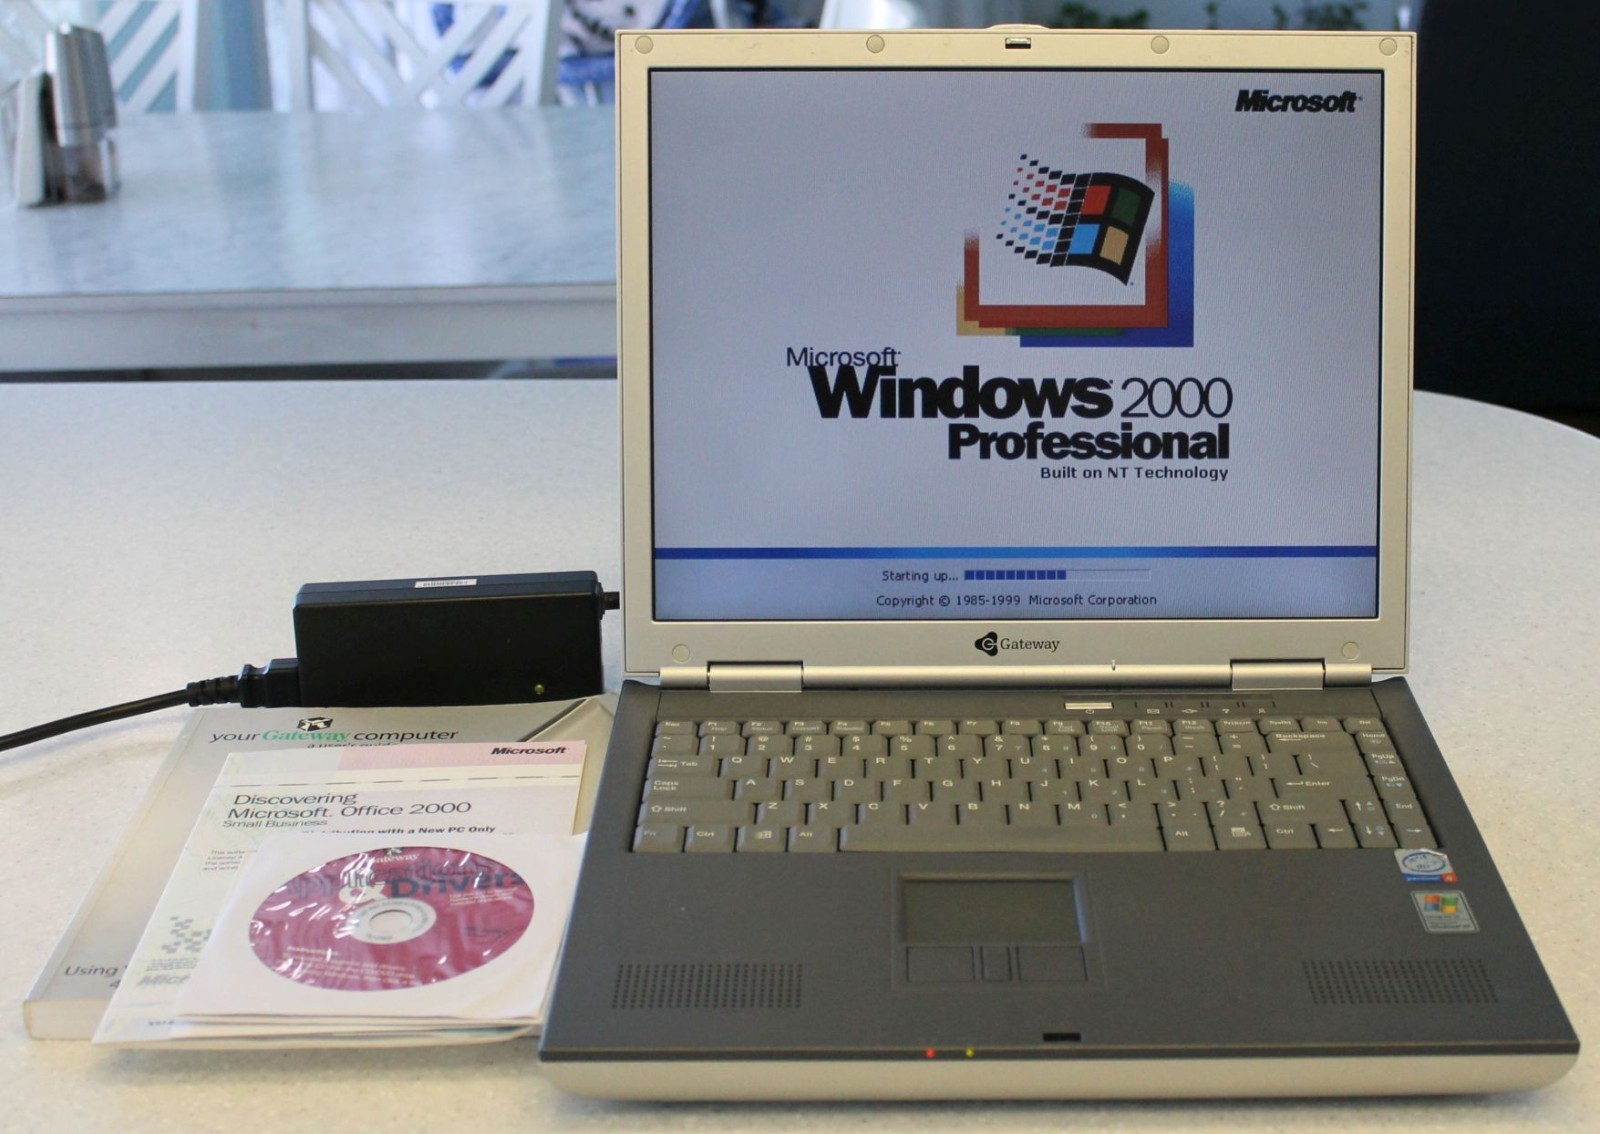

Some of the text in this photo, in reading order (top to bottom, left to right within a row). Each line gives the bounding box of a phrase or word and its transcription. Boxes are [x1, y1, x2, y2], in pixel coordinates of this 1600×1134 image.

[1235, 89, 1358, 112] Microsoft
[786, 347, 897, 369] Microsoft
[808, 364, 1232, 419] Windows 2000
[948, 422, 1229, 460] Professional
[1040, 466, 1229, 482] Built on NT Technology
[881, 570, 959, 584] Starting up...
[876, 594, 934, 608] Copyright
[956, 594, 1021, 606] 1985-1999
[1028, 593, 1084, 606] Microsoft
[1087, 593, 1157, 607] Corporation
[1000, 638, 1060, 653] Gateway
[210, 730, 460, 744] your Gateway computer
[491, 746, 567, 756] Microsoft
[234, 792, 359, 807] Discovering
[341, 804, 403, 817] Office
[409, 801, 472, 815] 2000
[222, 818, 329, 829] Small Business
[418, 826, 446, 834] New
[448, 826, 467, 834] PC
[469, 825, 497, 835] Only
[65, 965, 119, 978] Using
